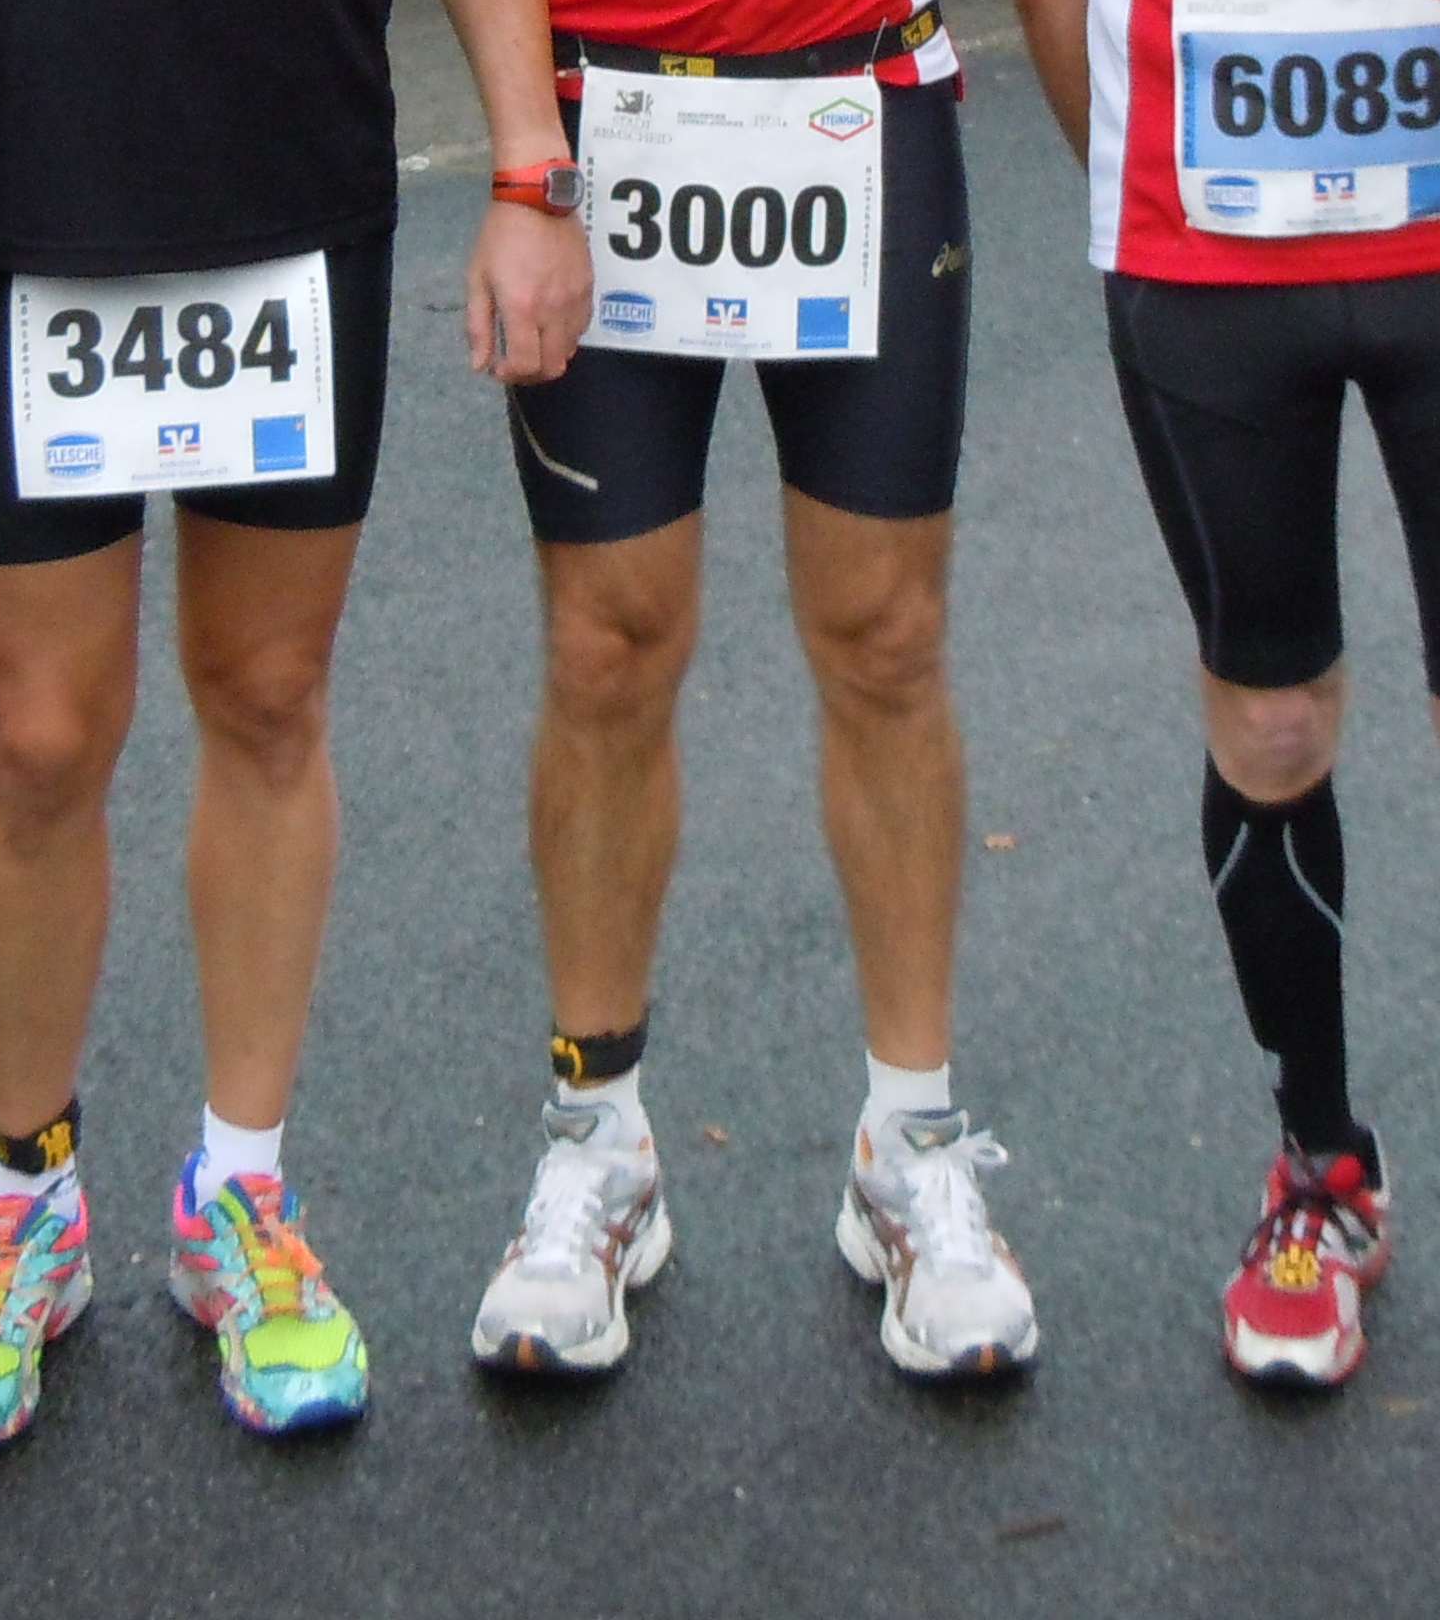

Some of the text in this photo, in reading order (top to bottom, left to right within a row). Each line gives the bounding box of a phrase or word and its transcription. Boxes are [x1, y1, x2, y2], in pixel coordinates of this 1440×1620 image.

[608, 178, 848, 269] 3000
[46, 298, 298, 399] 3484
[47, 446, 102, 465] FLESCHE
